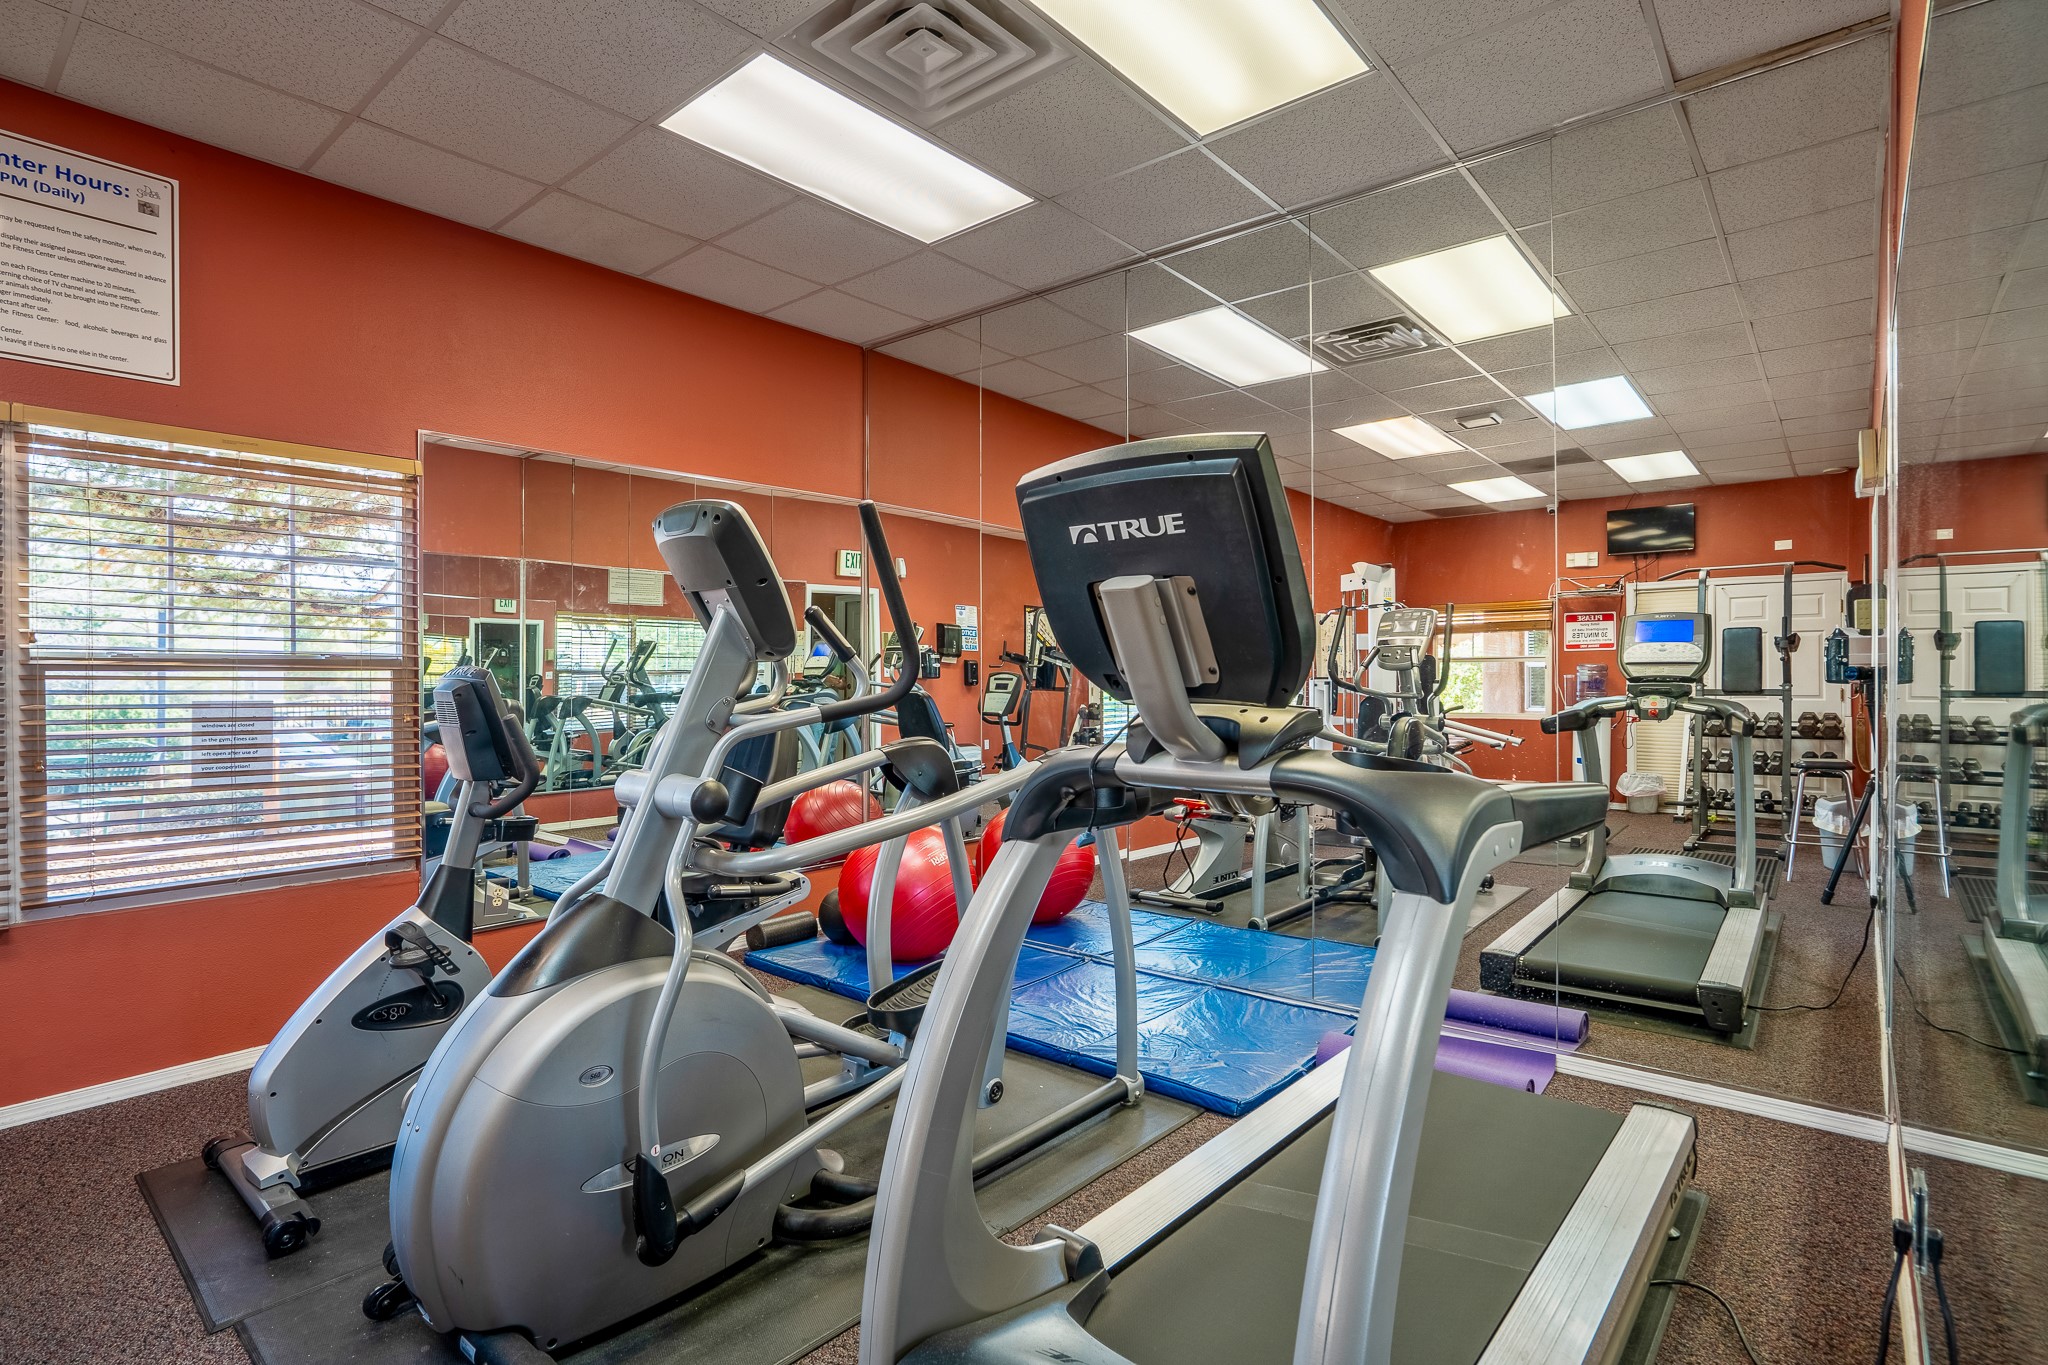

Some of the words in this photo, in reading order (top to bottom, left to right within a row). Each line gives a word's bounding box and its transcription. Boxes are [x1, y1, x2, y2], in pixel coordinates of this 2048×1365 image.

[0, 153, 48, 175] nter
[55, 165, 130, 198] Hours:
[0, 171, 28, 188] PM
[34, 180, 85, 205] (Daily)
[0, 232, 23, 243] display
[24, 237, 39, 246] their
[40, 242, 66, 252] assigned
[67, 248, 86, 257] passes
[24, 220, 55, 232] requested
[56, 227, 71, 235] from
[83, 234, 101, 243] safety
[102, 239, 126, 249] monitor,
[13, 244, 35, 255] Fitness
[36, 249, 56, 259] Center
[57, 256, 76, 264] unless
[77, 260, 106, 271] otherwise
[107, 267, 137, 277] authorized
[144, 275, 167, 284] advance
[27, 266, 48, 275] Fitness
[49, 271, 69, 280] Center
[70, 276, 95, 286] machine
[5, 281, 30, 290] animals
[31, 286, 52, 295] should
[73, 294, 96, 303] brought
[120, 303, 140, 312] Fitness
[13, 291, 53, 305] immediately.
[22, 275, 43, 284] choice
[61, 283, 84, 292] channel
[97, 290, 118, 299] volume
[21, 302, 36, 310] after
[0, 326, 24, 336] Center.
[12, 310, 34, 319] Fitness
[36, 314, 59, 324] Center:
[64, 320, 80, 328] food,
[83, 323, 109, 333] alcoholic
[111, 328, 139, 339] beverages
[4, 336, 27, 346] leaving
[33, 341, 50, 350] there
[79, 349, 91, 357] else
[98, 352, 109, 360] the
[109, 355, 129, 363] center.
[1097, 513, 1186, 541] TRUE
[389, 1005, 407, 1020] 8.0
[661, 1157, 685, 1168] ITNESS
